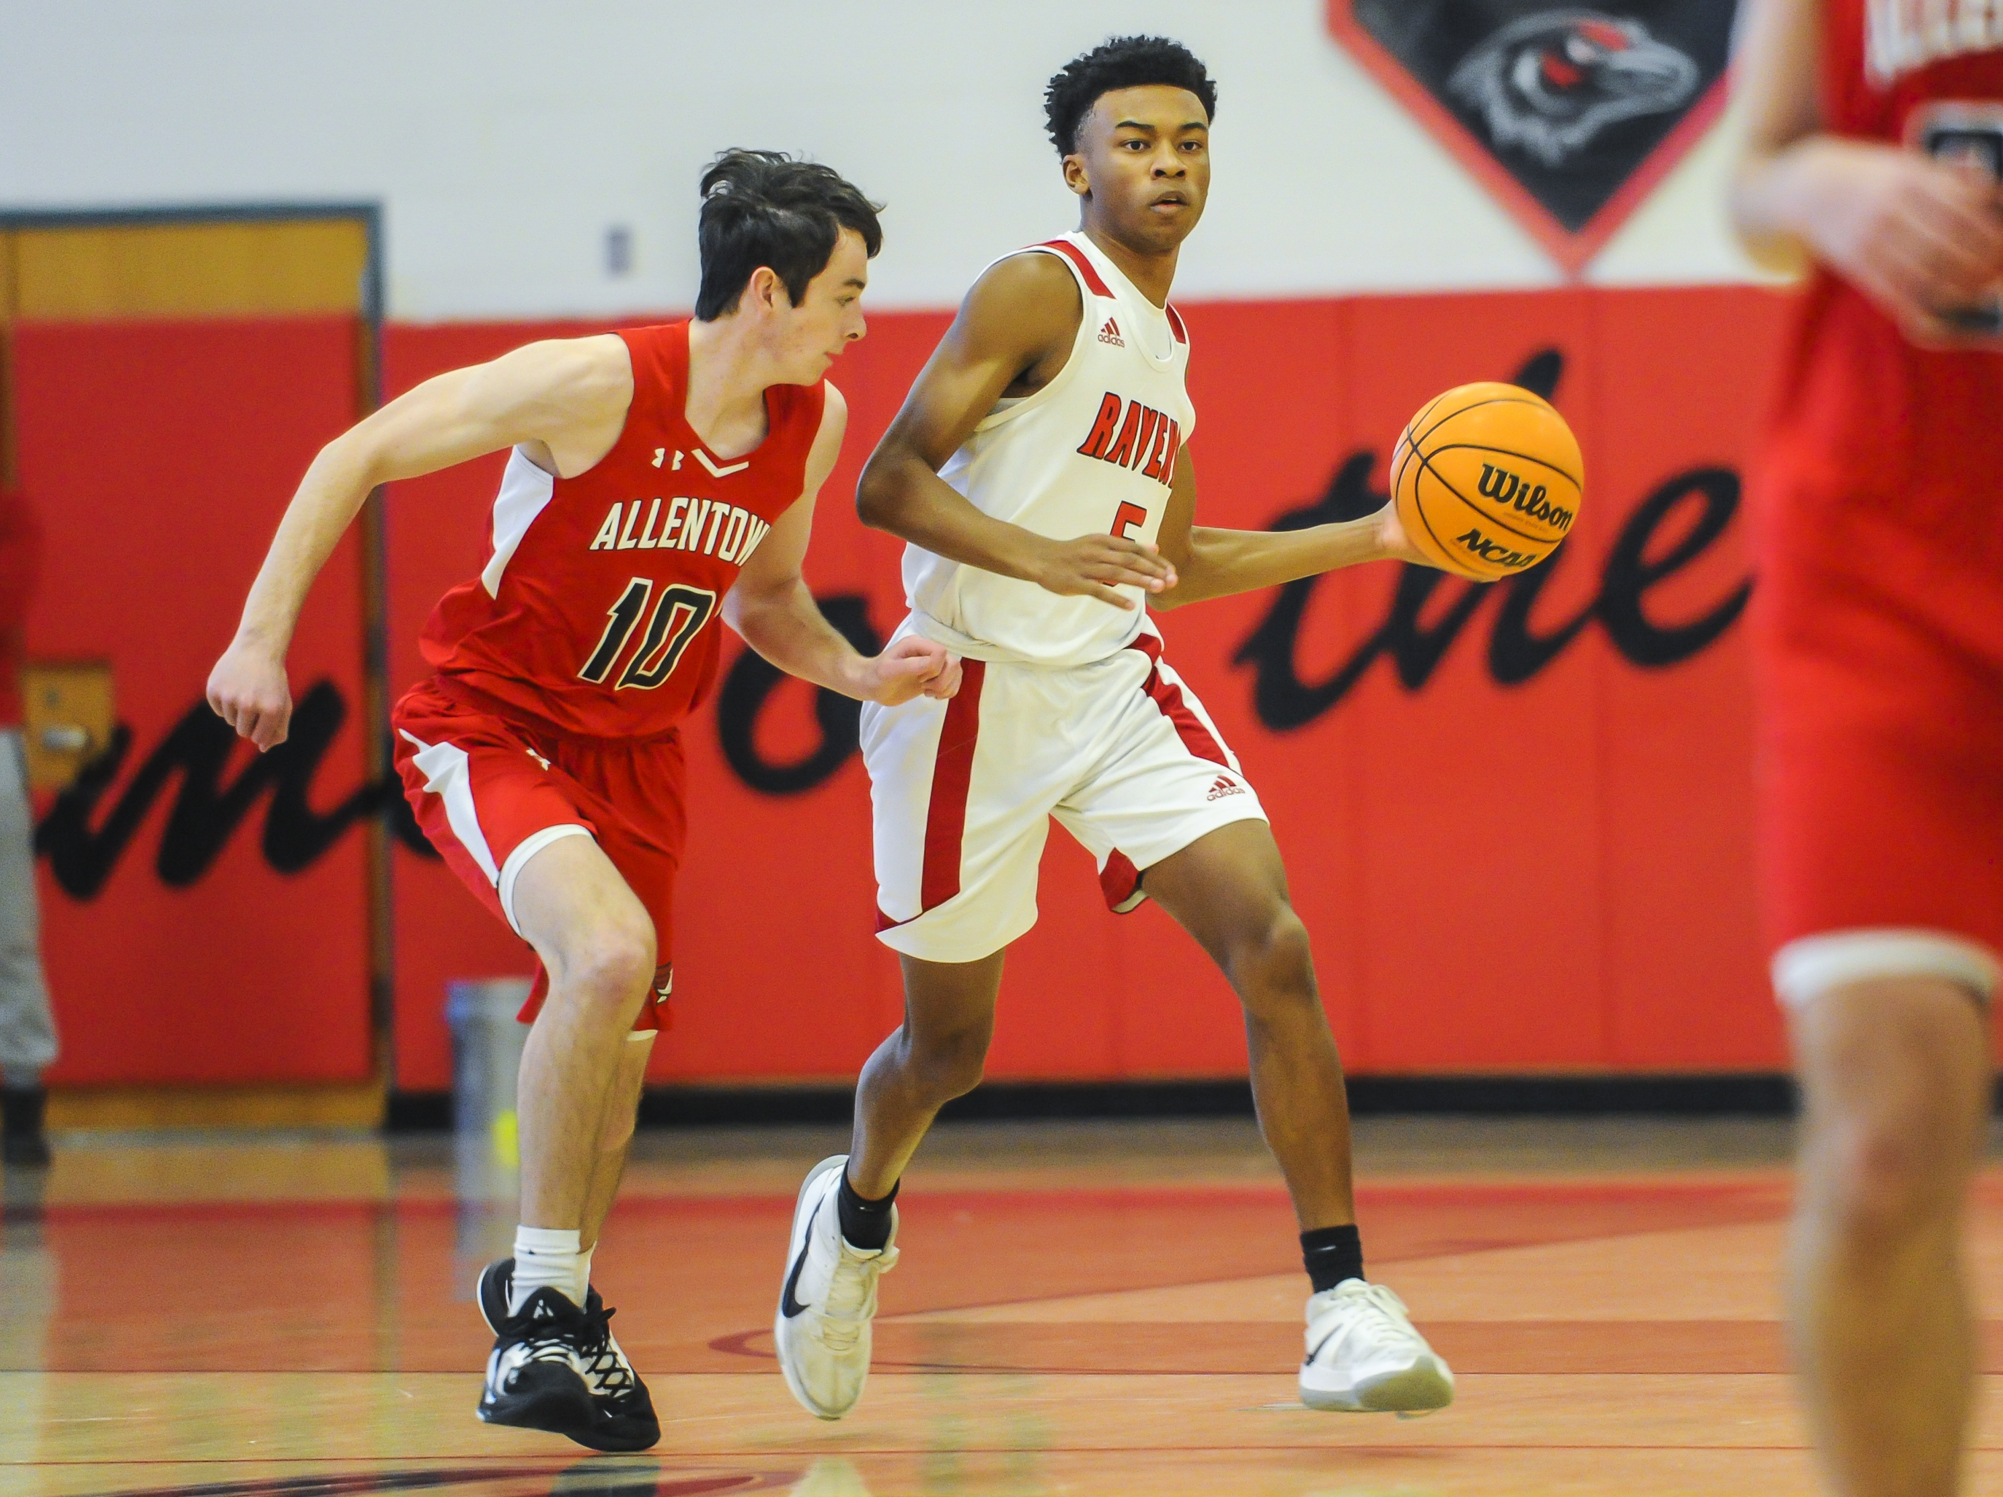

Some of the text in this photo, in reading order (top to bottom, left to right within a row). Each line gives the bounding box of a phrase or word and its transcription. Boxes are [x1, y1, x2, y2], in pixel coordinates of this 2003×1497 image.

[1097, 333, 1125, 349] adidas
[588, 496, 772, 568] ALLENTOW
[1477, 462, 1573, 532] Wilson
[1231, 345, 1757, 733] the
[1456, 528, 1538, 568] NCAA
[576, 576, 717, 692] 10
[1206, 786, 1246, 801] adidas
